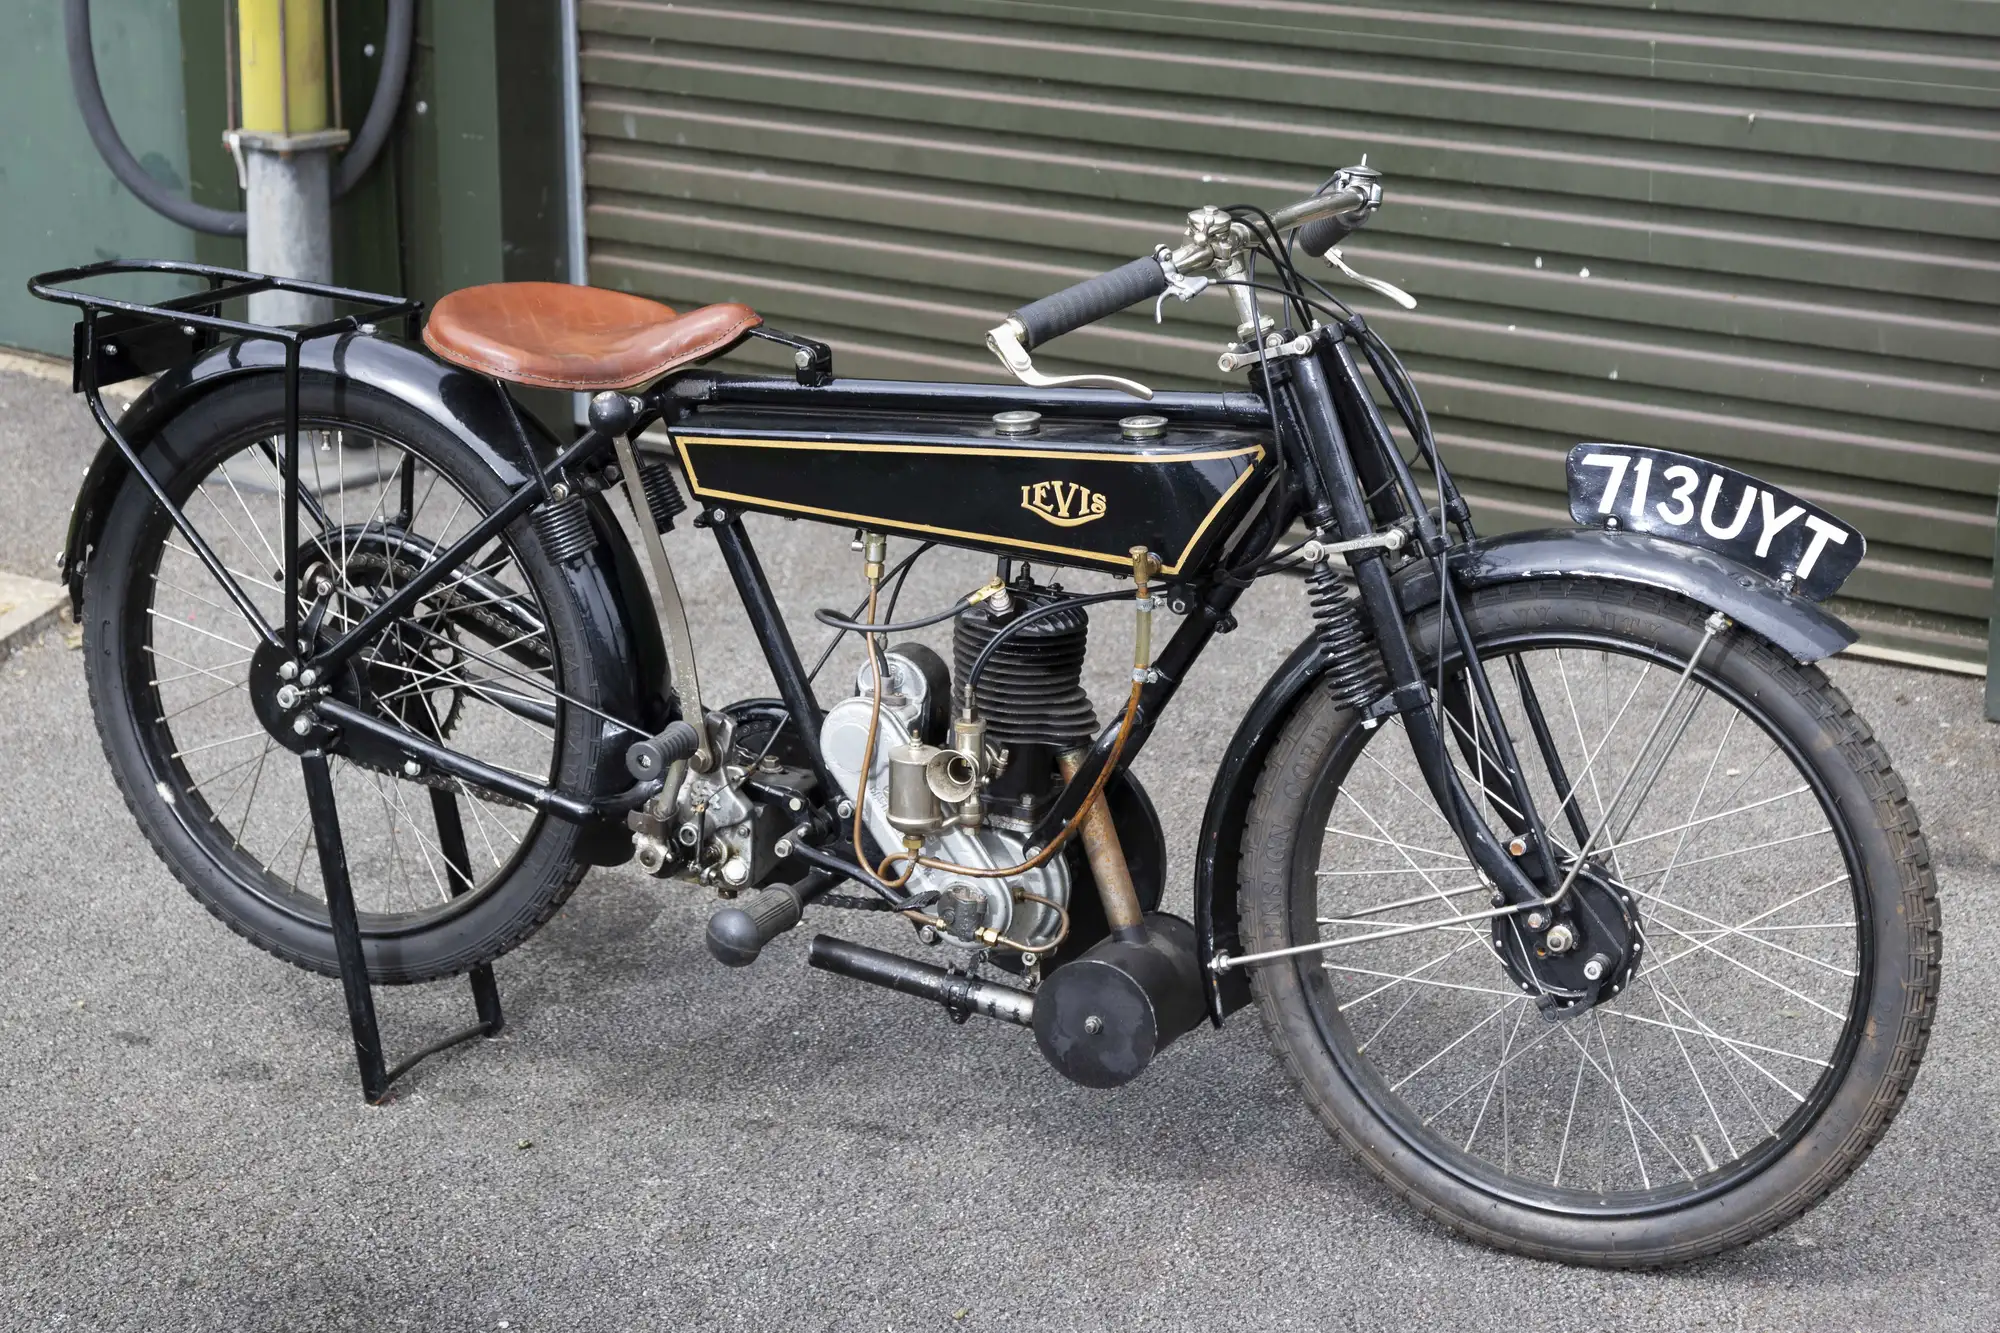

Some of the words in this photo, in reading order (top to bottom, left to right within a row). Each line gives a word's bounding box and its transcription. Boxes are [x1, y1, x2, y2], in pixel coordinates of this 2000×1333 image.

[1020, 480, 1107, 527] LEVIS
[1581, 453, 1849, 579] 713UYT
[1261, 818, 1293, 940] ENSIGN
[1284, 725, 1334, 800] CORD
